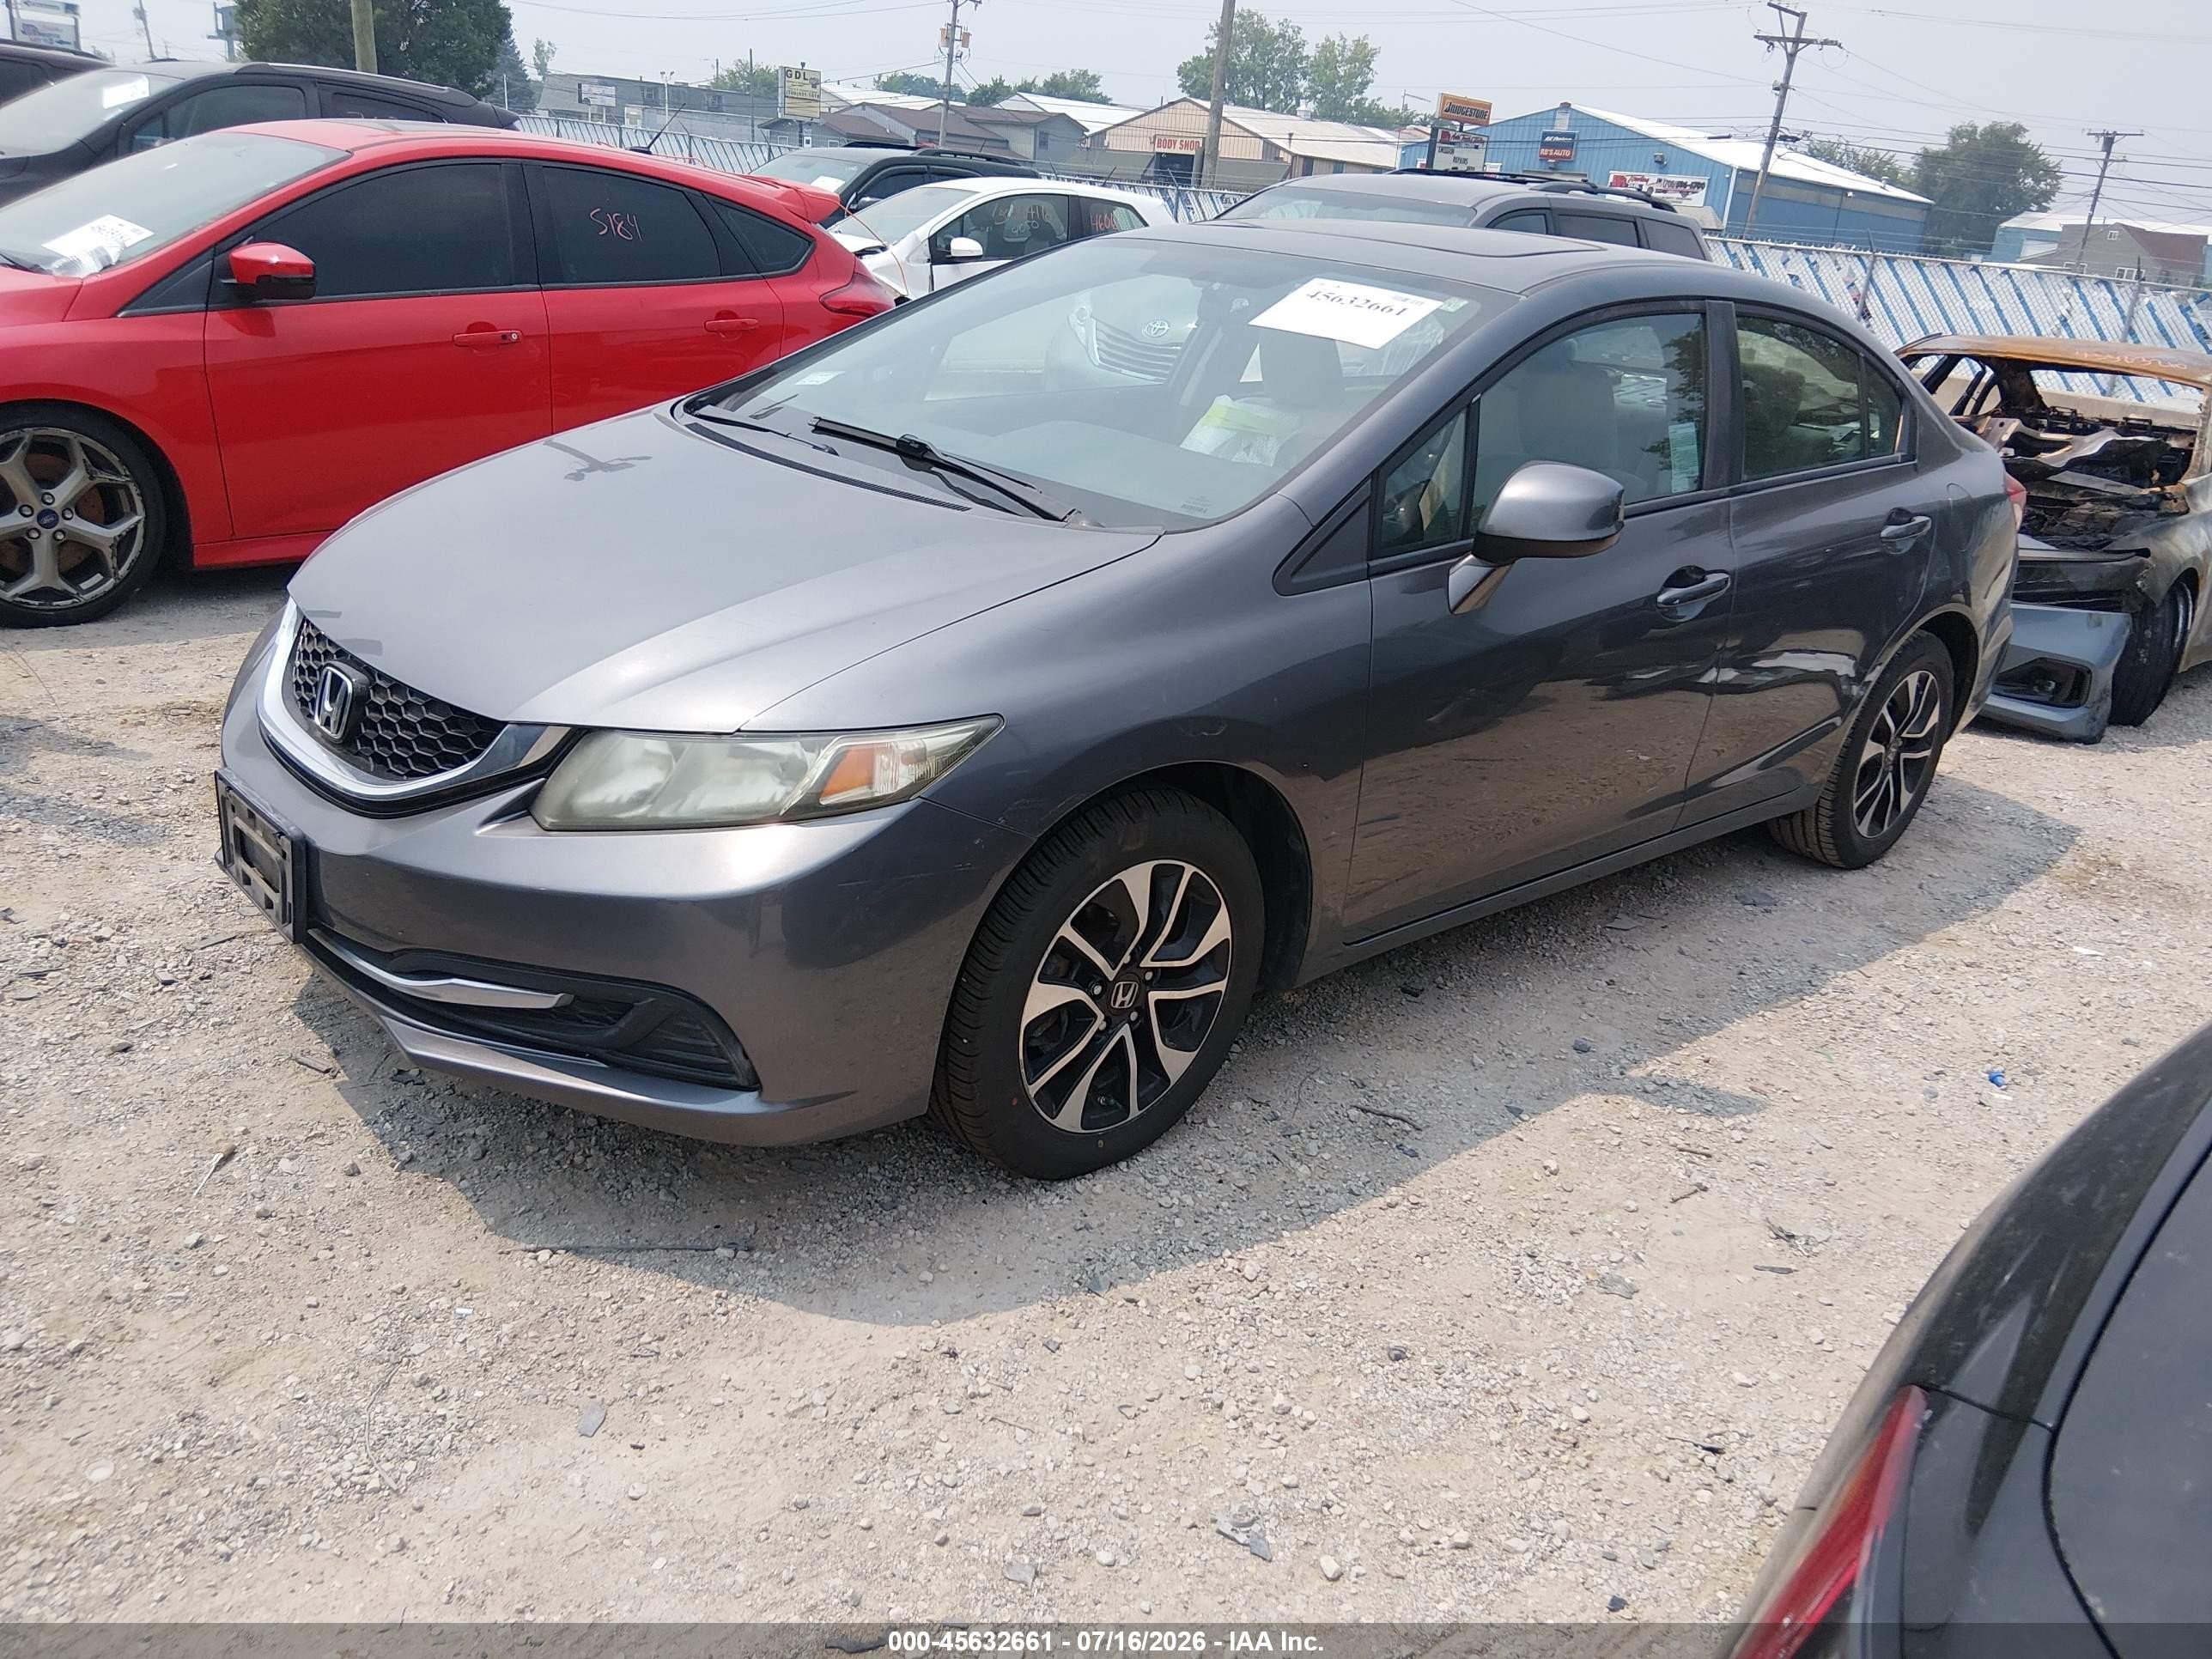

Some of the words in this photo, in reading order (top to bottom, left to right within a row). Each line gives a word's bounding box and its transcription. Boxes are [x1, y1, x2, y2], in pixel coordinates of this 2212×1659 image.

[786, 70, 808, 81] GDL
[1444, 101, 1488, 119] BRIDGESTONE
[1157, 138, 1177, 149] BODY
